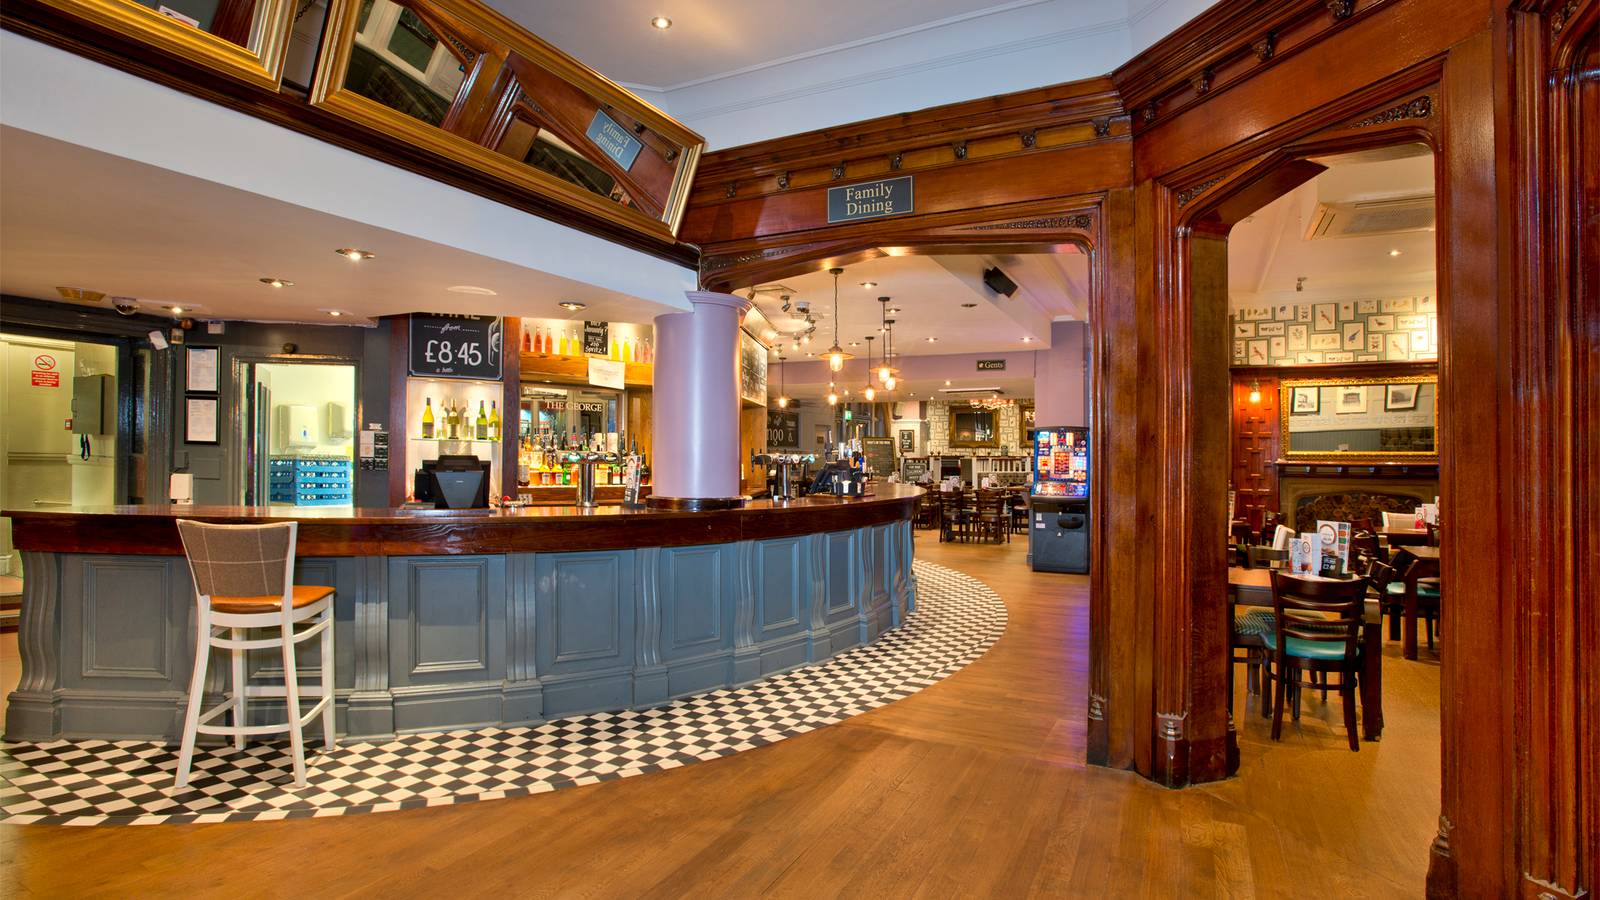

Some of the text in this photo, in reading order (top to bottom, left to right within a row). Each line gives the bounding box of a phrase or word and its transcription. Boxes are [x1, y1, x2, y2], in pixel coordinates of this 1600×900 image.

[846, 183, 893, 201] Family
[847, 200, 894, 216] Dining
[440, 323, 461, 334] from
[984, 361, 1004, 369] Gents
[545, 401, 603, 412] THE GEORGE
